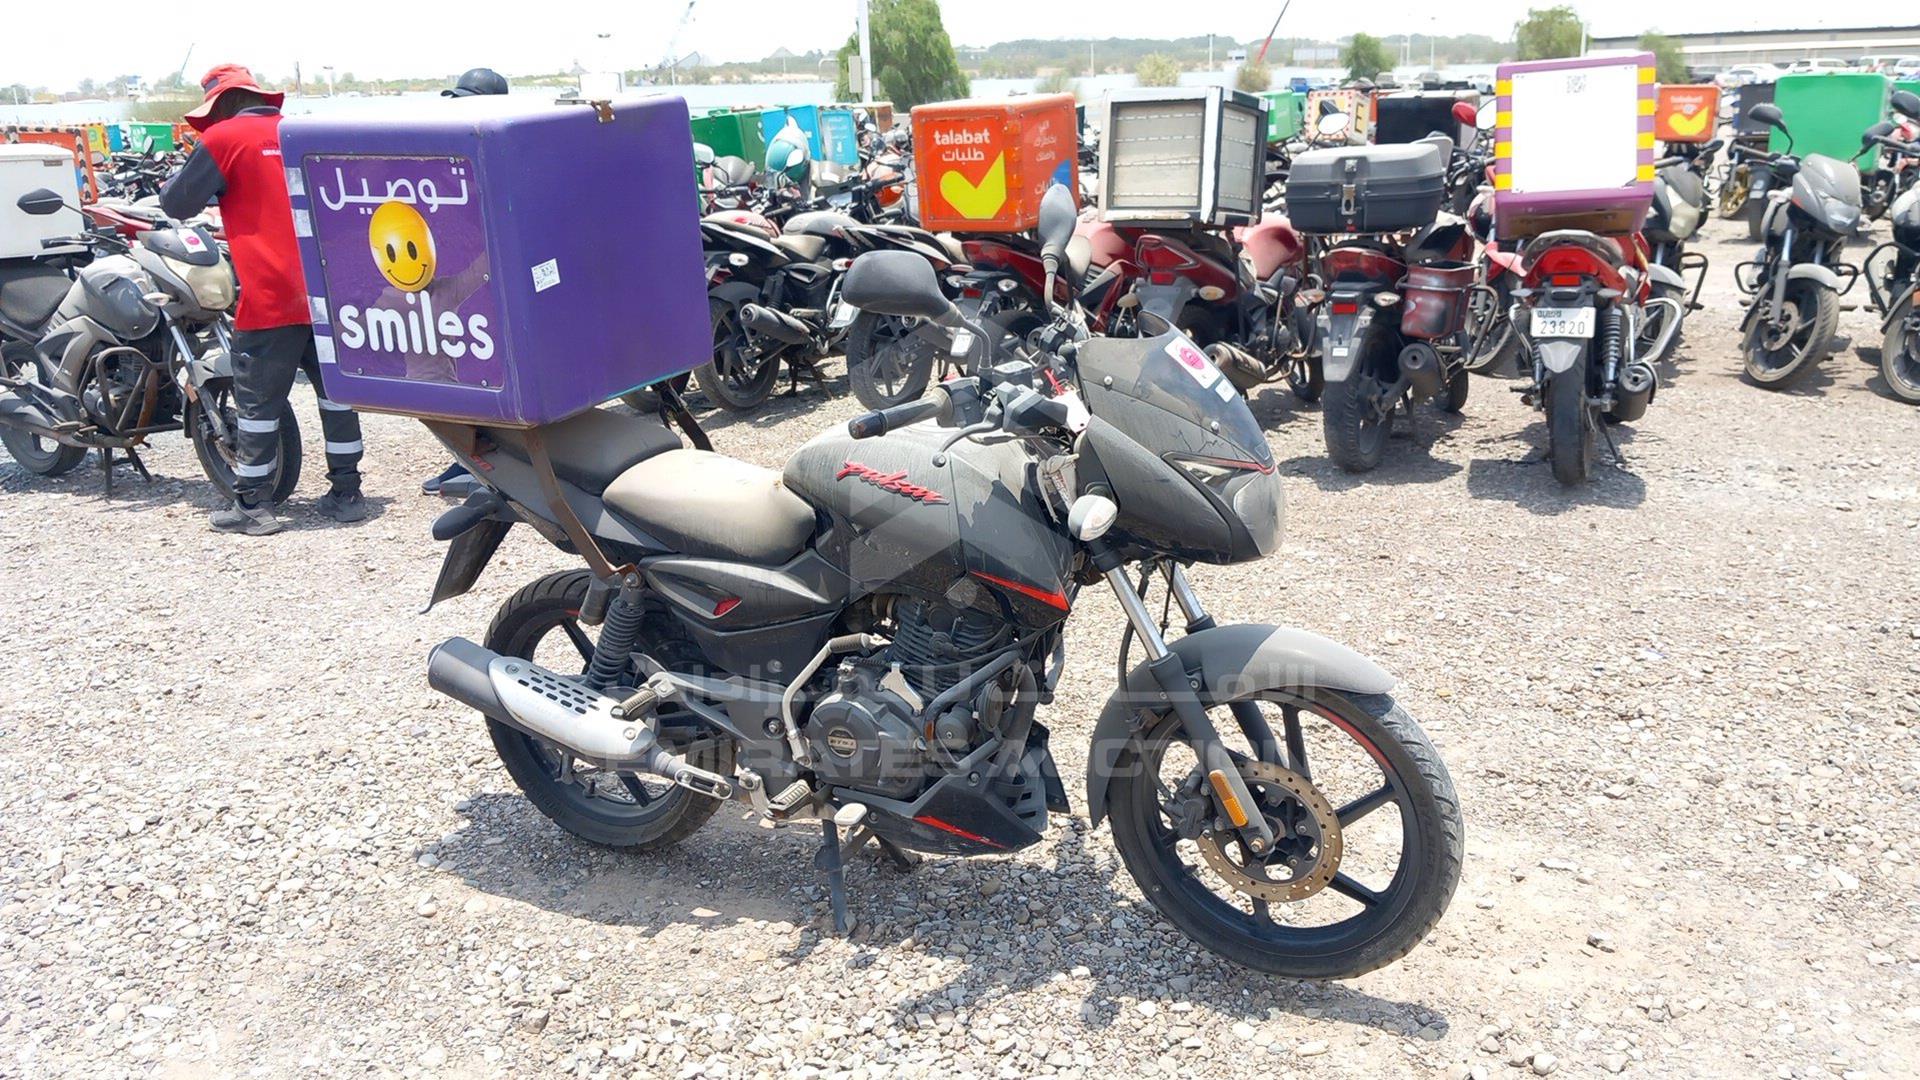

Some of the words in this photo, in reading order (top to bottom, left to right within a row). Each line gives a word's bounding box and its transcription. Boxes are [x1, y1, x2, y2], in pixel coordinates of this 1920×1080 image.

[933, 127, 991, 146] talabat
[941, 147, 985, 165] طلبات
[319, 166, 469, 215] توصيل
[338, 290, 495, 361] smiles
